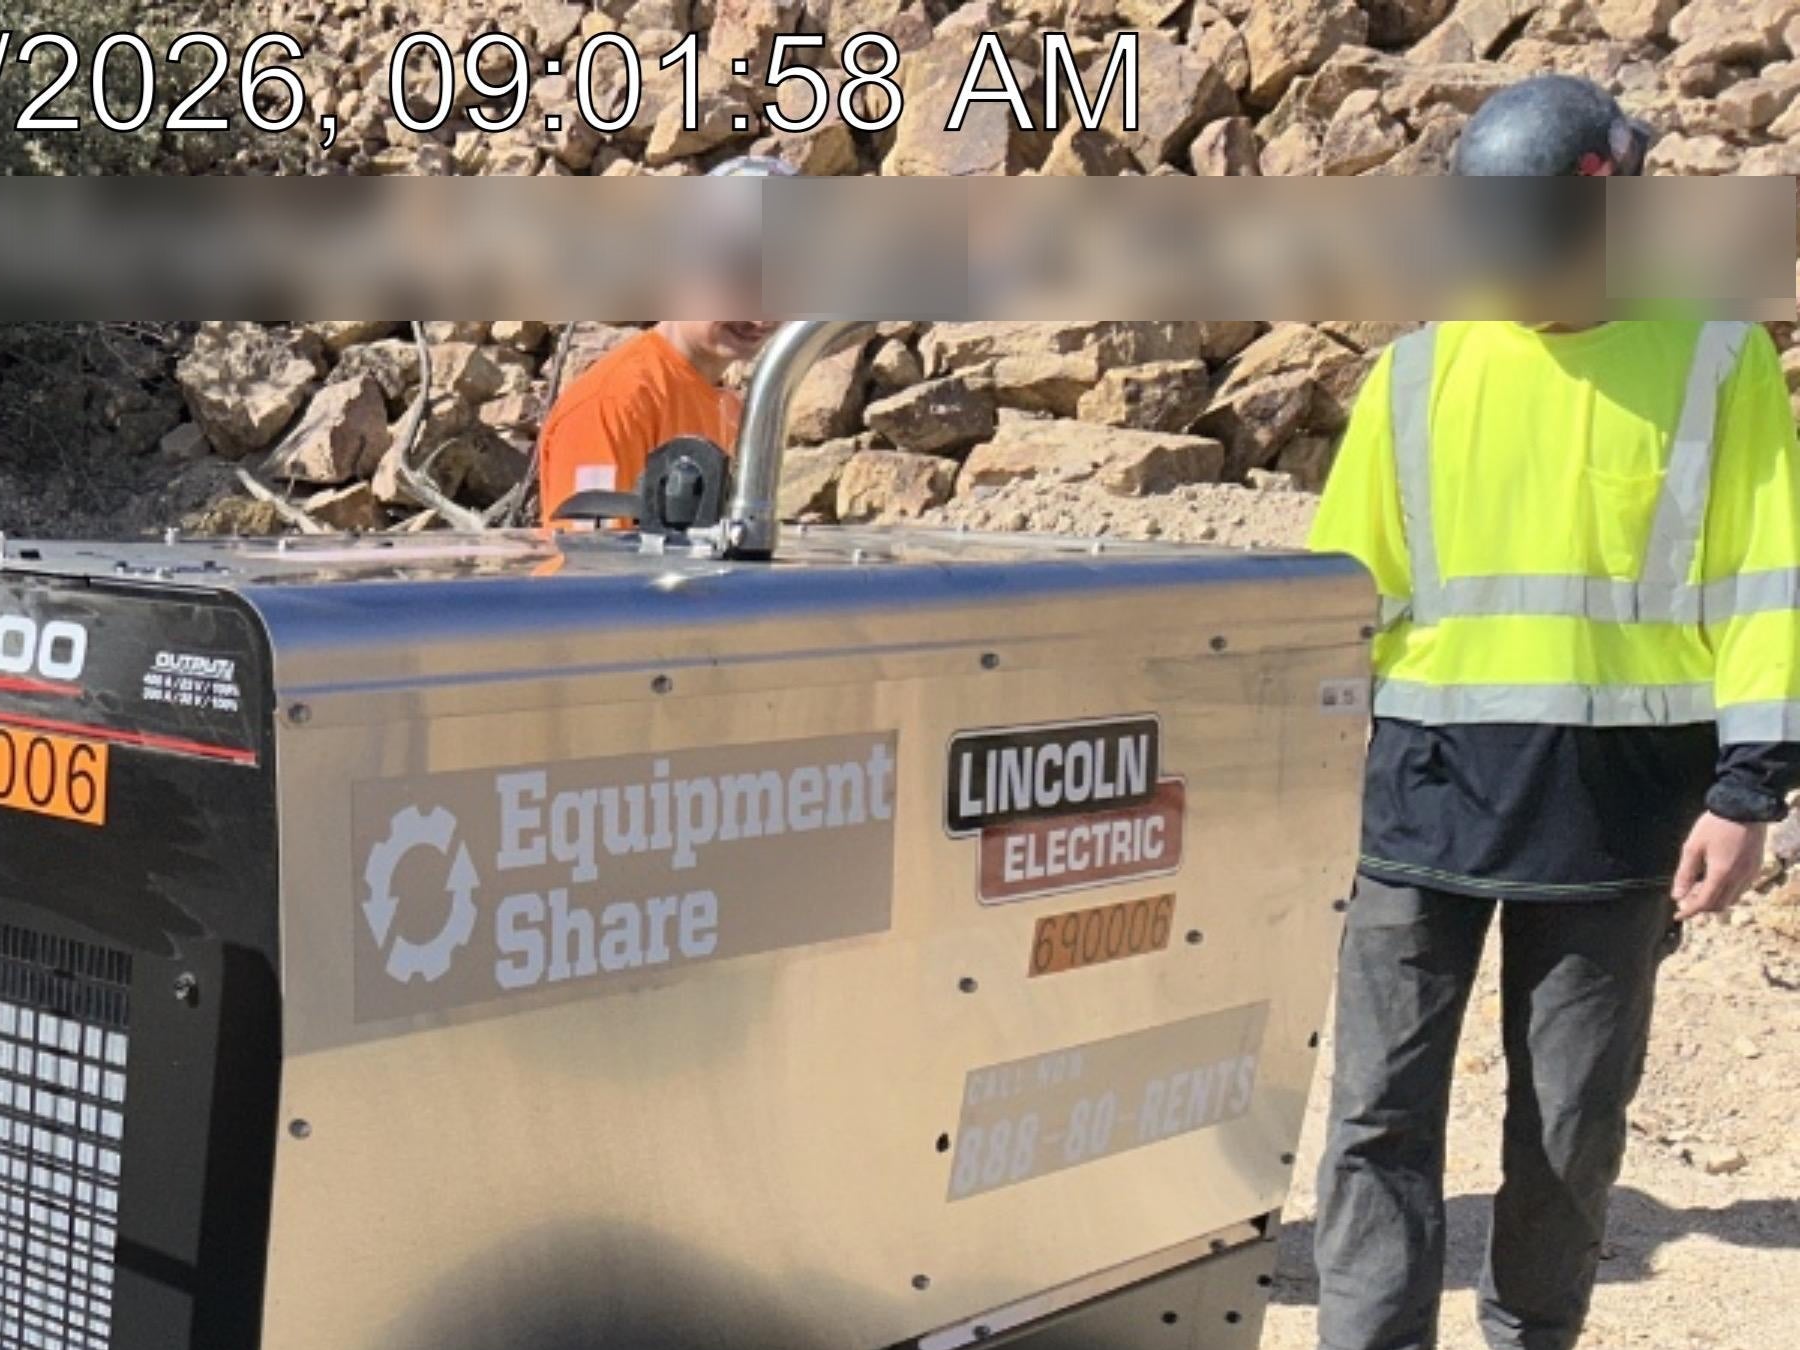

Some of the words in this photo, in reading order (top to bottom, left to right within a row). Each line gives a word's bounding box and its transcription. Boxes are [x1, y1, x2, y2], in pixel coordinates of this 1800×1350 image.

[495, 743, 893, 882] Equipment
[959, 734, 1149, 818] LINCOLN
[1004, 815, 1165, 883] ELECTRIC
[495, 888, 718, 990] Share
[1033, 898, 1174, 974] 690006
[953, 1055, 1256, 1195] 888-80-RENTS
